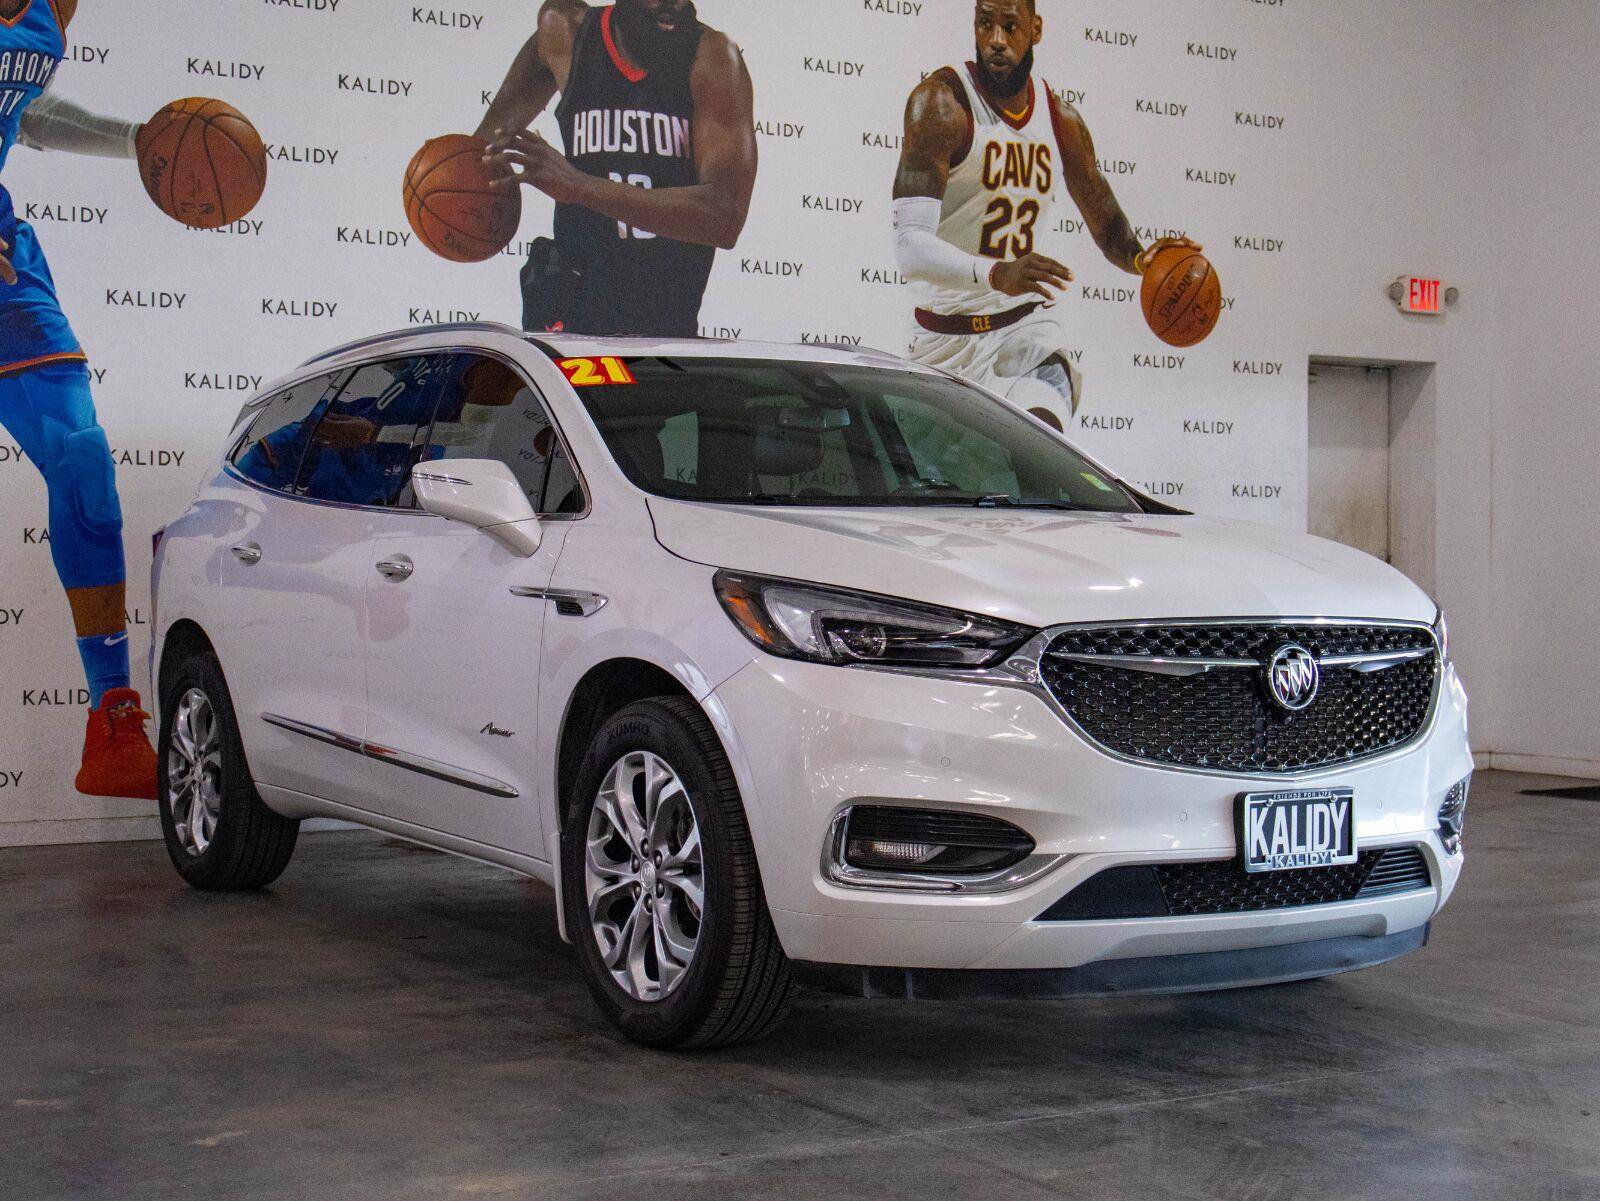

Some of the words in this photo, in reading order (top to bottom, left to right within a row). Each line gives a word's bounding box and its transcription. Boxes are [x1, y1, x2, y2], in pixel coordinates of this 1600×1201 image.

[413, 8, 483, 30] KALIDY
[1085, 28, 1137, 47] KALIDY
[63, 45, 110, 64] IDY
[1187, 43, 1236, 61] KALIDY
[0, 51, 54, 86] AHOM
[188, 58, 264, 80] KALIDY
[804, 57, 864, 76] KALIDY
[339, 74, 412, 96] KALIDY
[0, 90, 25, 115] TY
[1060, 89, 1085, 104] IDY
[1136, 99, 1187, 117] KALIDY
[753, 120, 804, 138] ALIDY
[1236, 112, 1284, 129] KALIDY
[573, 110, 689, 157] HOUSTON
[863, 132, 904, 150] KALI
[264, 144, 338, 165] KALIDY
[983, 140, 1051, 193] CAVS
[1096, 159, 1136, 175] ALIDY
[1186, 168, 1236, 185] KALIDY
[26, 203, 107, 223] KALIDY
[803, 195, 862, 213] KALIDY
[979, 196, 1040, 259] 23
[1053, 219, 1084, 234] IDY
[337, 227, 411, 245] KALIDY
[1235, 236, 1283, 252] KALIDY
[742, 259, 802, 276] KALIDY
[862, 268, 908, 284] KALI
[107, 289, 186, 308] KALIDY
[1083, 286, 1135, 302] KALIDY
[1409, 279, 1440, 311] EXIT
[263, 299, 337, 317] KALIDY
[972, 316, 991, 331] CLE
[560, 357, 632, 384] 21
[1134, 354, 1184, 369] KALIDY
[1233, 361, 1282, 375] KALIDY
[185, 372, 262, 390] KALIDY
[1081, 416, 1133, 430] KALIDY
[1184, 420, 1233, 434] KALIDY
[1142, 482, 1183, 496] ALIDY
[1232, 485, 1281, 498] KALIDY
[23, 689, 90, 706] KALID
[1250, 801, 1348, 857] KALIDY
[1274, 852, 1328, 868] KALIDY
